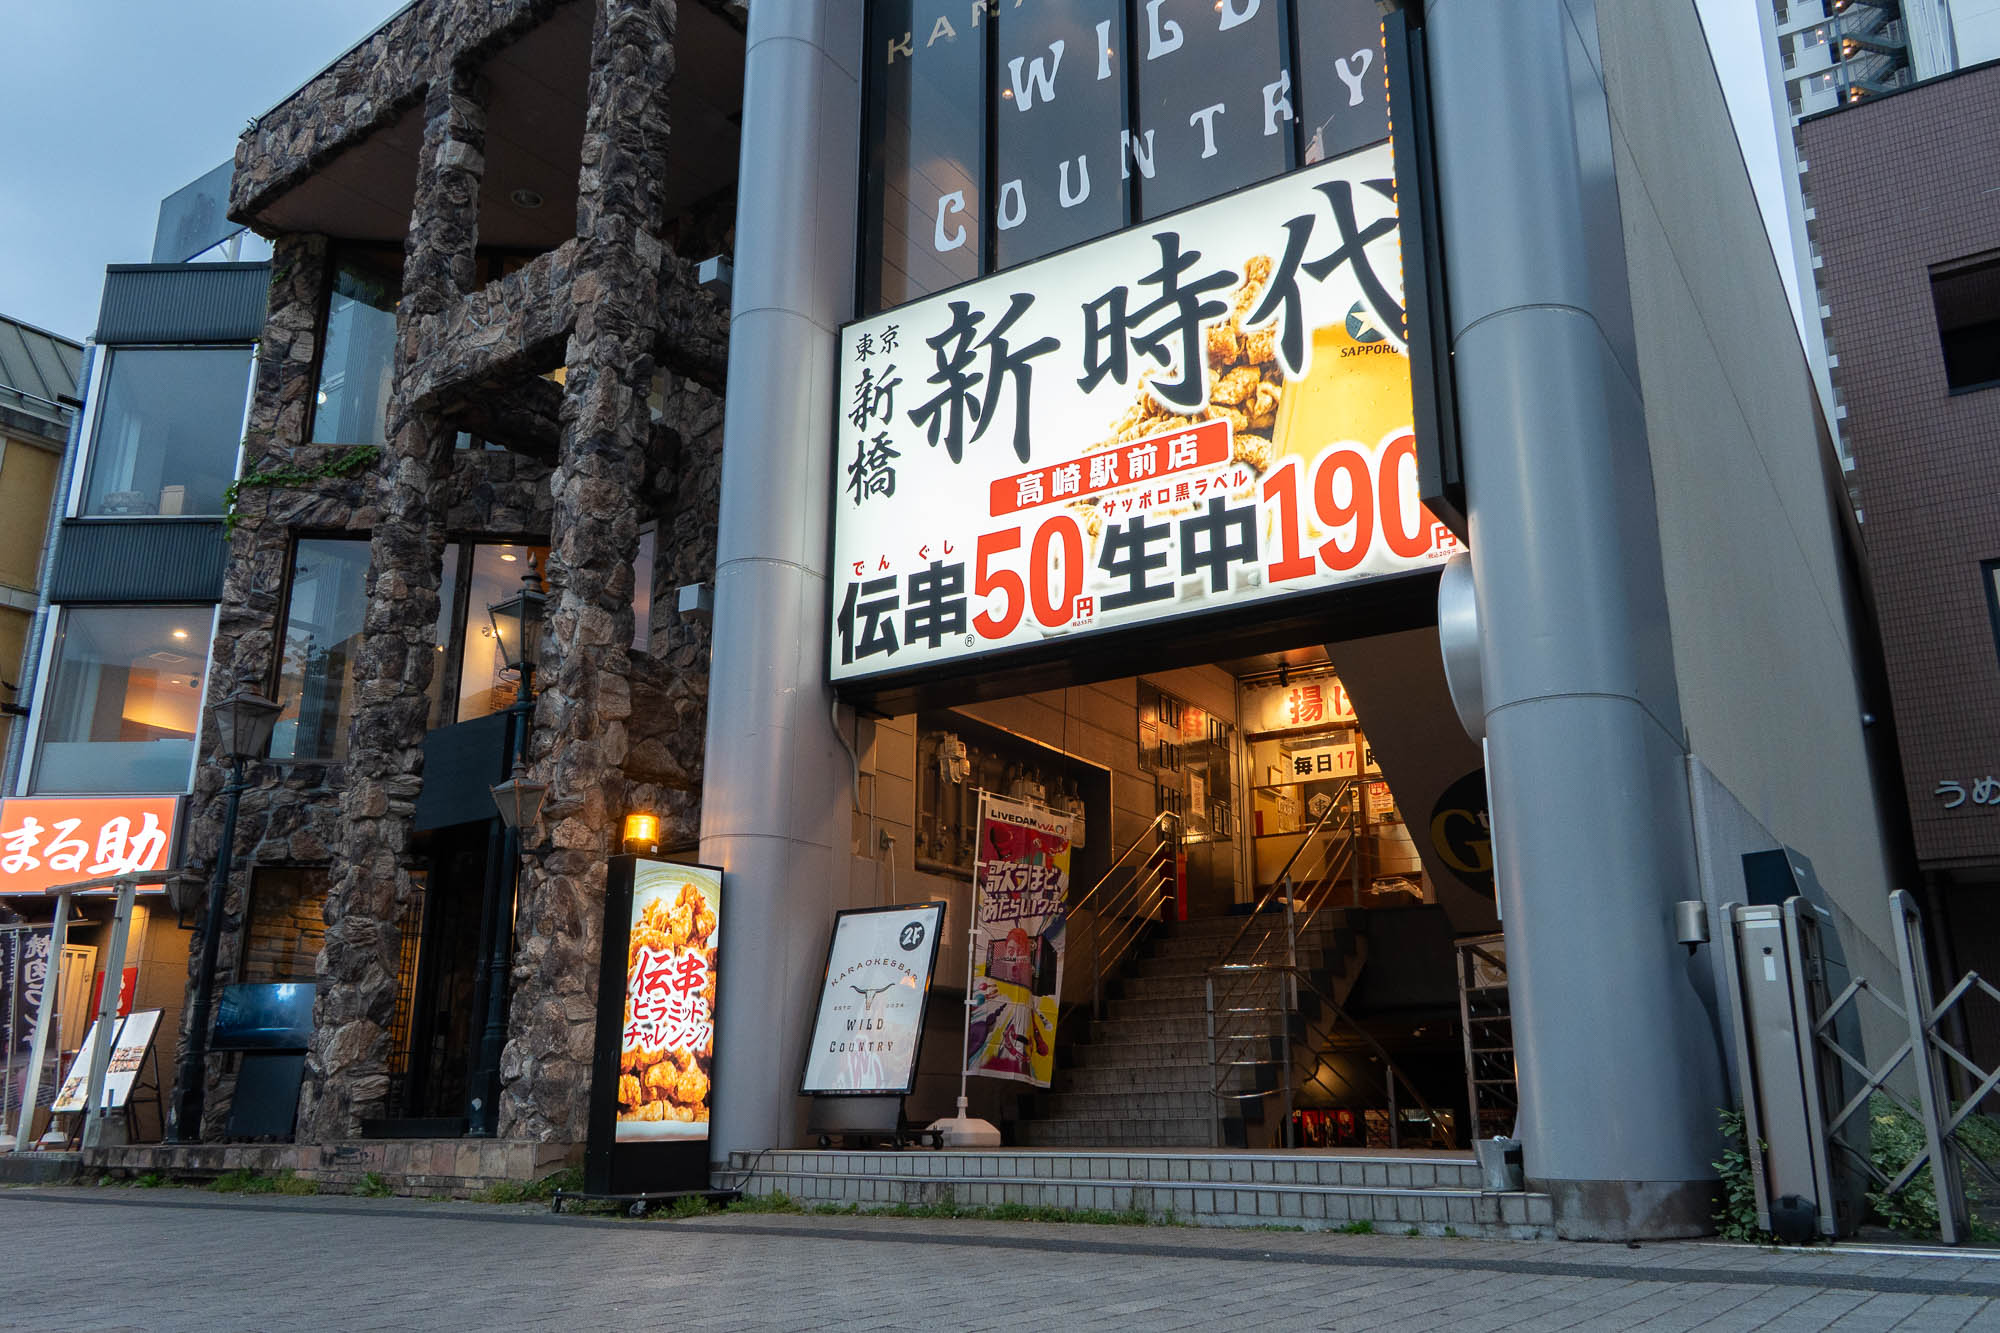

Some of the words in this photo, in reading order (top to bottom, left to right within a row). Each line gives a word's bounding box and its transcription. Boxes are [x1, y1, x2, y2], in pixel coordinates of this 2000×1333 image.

[934, 48, 1374, 252] COUNTRY
[855, 325, 899, 361] 東京
[907, 180, 1409, 465] 新時代
[845, 363, 903, 506] 新橋
[1016, 433, 1198, 508] 高崎駅前店
[1103, 470, 1247, 517] サッポロ黒ラベル
[853, 555, 890, 576] でん
[918, 540, 954, 560] ぐし
[1098, 495, 1258, 612] 生中
[1934, 776, 2000, 808] うめ
[0, 812, 167, 877] まる助
[902, 926, 923, 945] 2F
[632, 950, 705, 999] 伝串
[632, 997, 704, 1022] ピラミッド
[847, 1018, 884, 1031] WILD
[829, 1040, 893, 1053] COUNTRY
